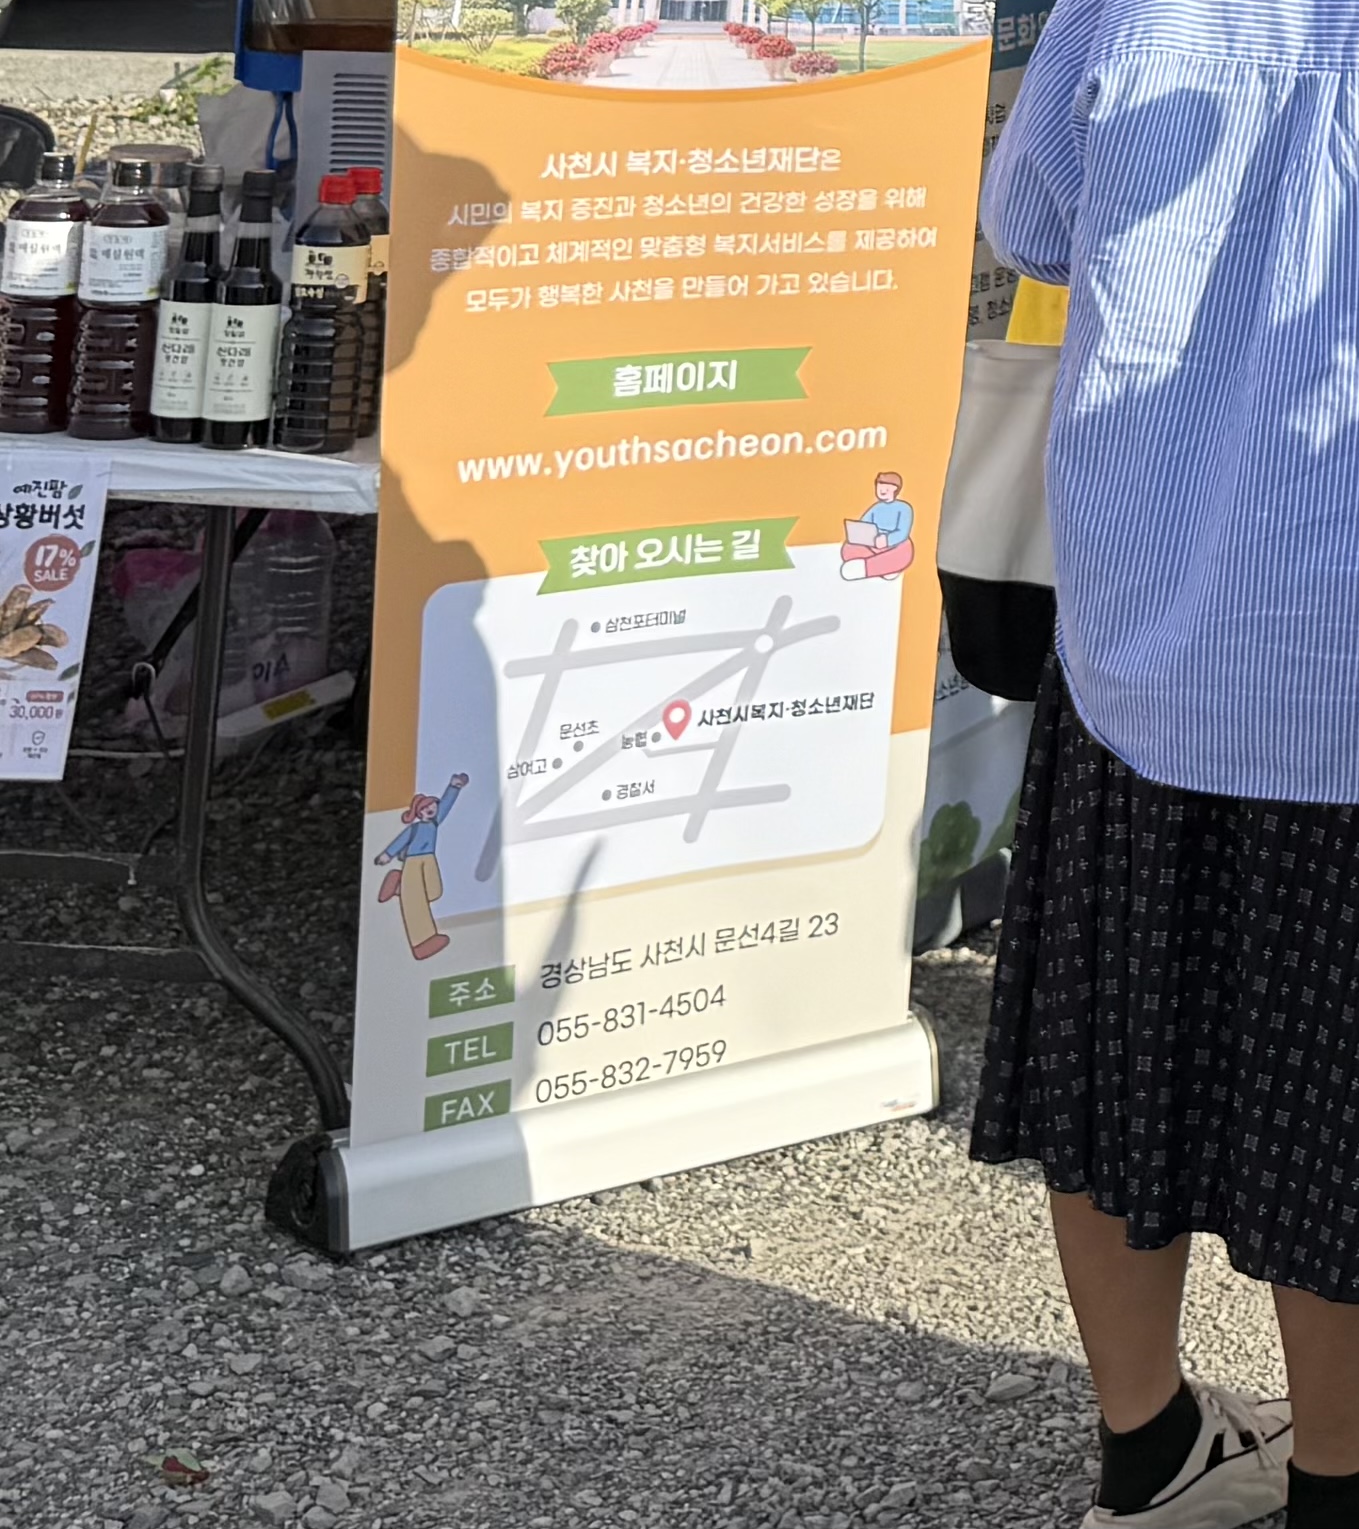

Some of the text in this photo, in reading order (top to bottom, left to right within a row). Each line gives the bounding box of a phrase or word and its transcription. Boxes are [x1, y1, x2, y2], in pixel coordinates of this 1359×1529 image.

[540, 146, 842, 181] 사천시 복지·청소년재단은
[448, 185, 927, 228] 시민의 복지 증진과 청소년의 건강한 성장을 위해
[430, 225, 938, 273] 종합적이고 체계적인 맞춤형 복지서비스를 제공하여
[465, 268, 899, 313] 모두가 행복한 사천을 만들어 가고 있습니다.
[612, 360, 739, 398] 홈페이지
[456, 422, 888, 485] www.youthsacheon.com
[35, 544, 77, 567] 17%
[569, 529, 762, 580] 찾아 오시는 길
[33, 568, 68, 582] SALE
[605, 608, 687, 635] 삼천포터미널
[559, 719, 600, 741] 문선초
[620, 729, 648, 751] 농협
[615, 778, 656, 801] 경찰서
[540, 912, 840, 990] 경상남도 사천시 문선4길 23
[447, 979, 498, 1009] 주소
[537, 983, 728, 1047] 055-831-4504
[444, 1035, 498, 1066] TEL
[535, 1039, 728, 1104] 055-832-7959
[440, 1091, 496, 1126] FAX
